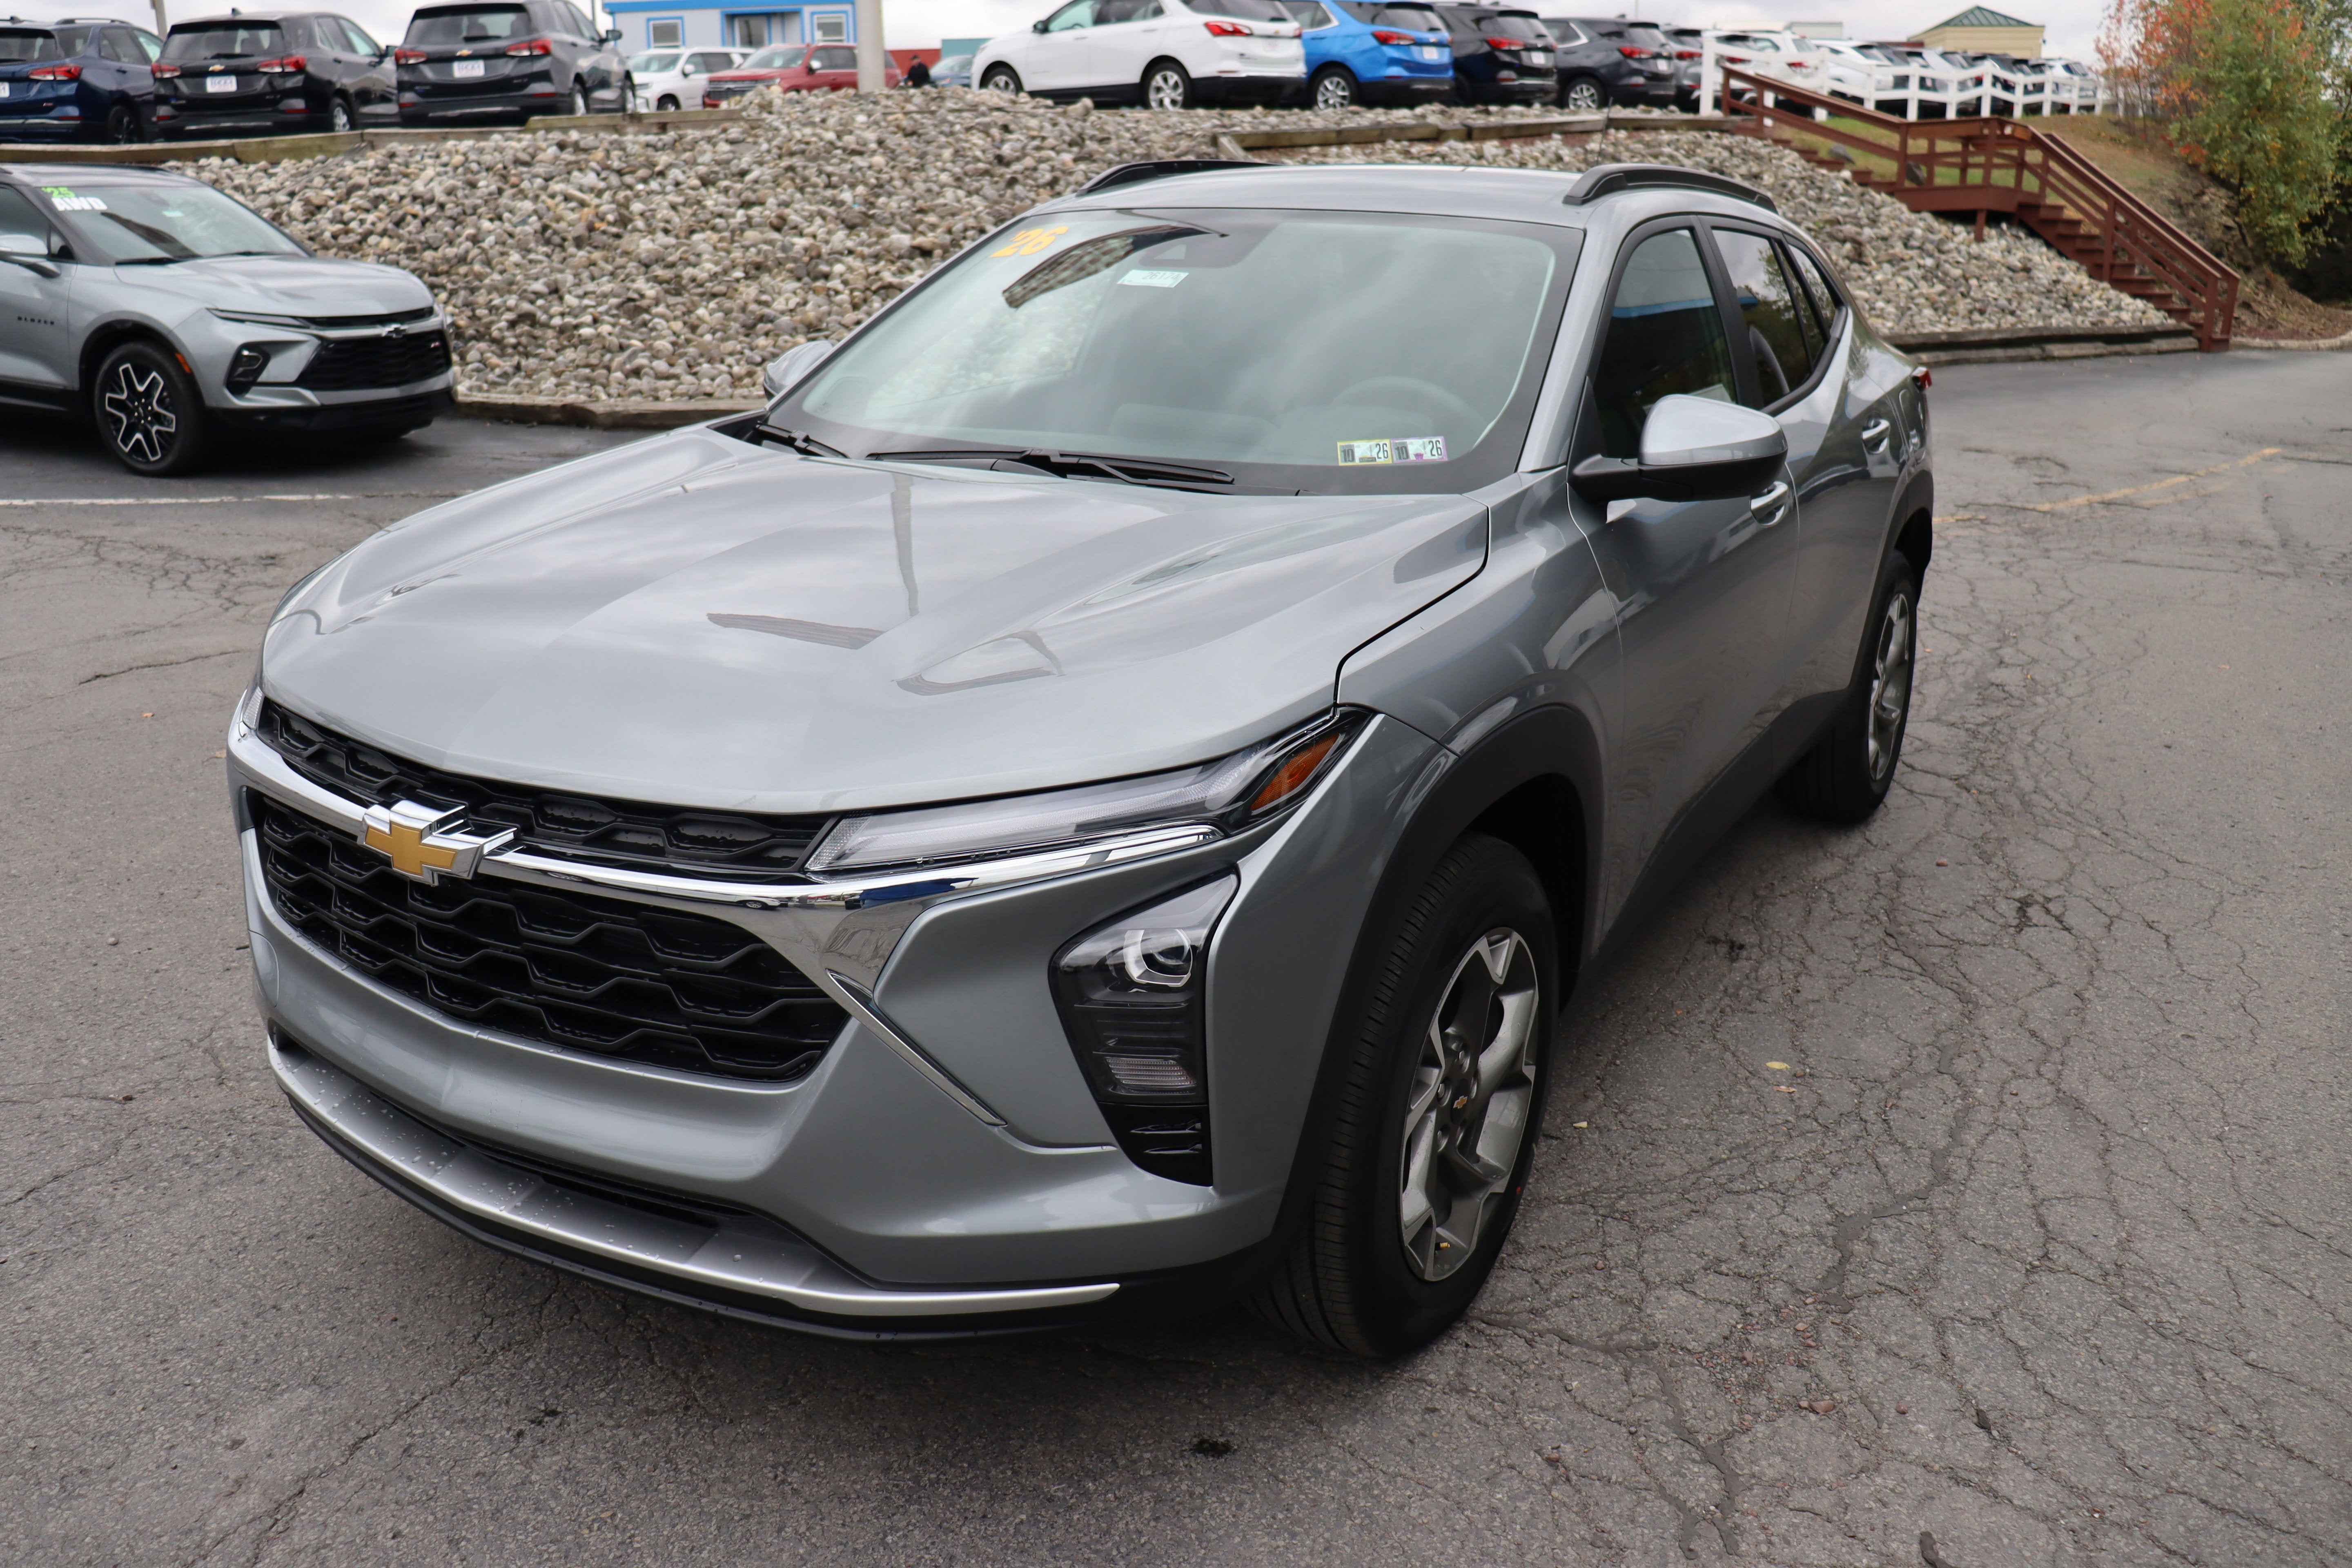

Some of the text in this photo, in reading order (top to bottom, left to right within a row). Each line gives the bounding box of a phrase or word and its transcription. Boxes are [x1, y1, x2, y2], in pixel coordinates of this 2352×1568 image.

[51, 197, 108, 212] AWD
[1142, 272, 1181, 281] 26174
[1375, 443, 1389, 459] 26
[1394, 445, 1409, 460] 10
[1428, 440, 1443, 457] 26
